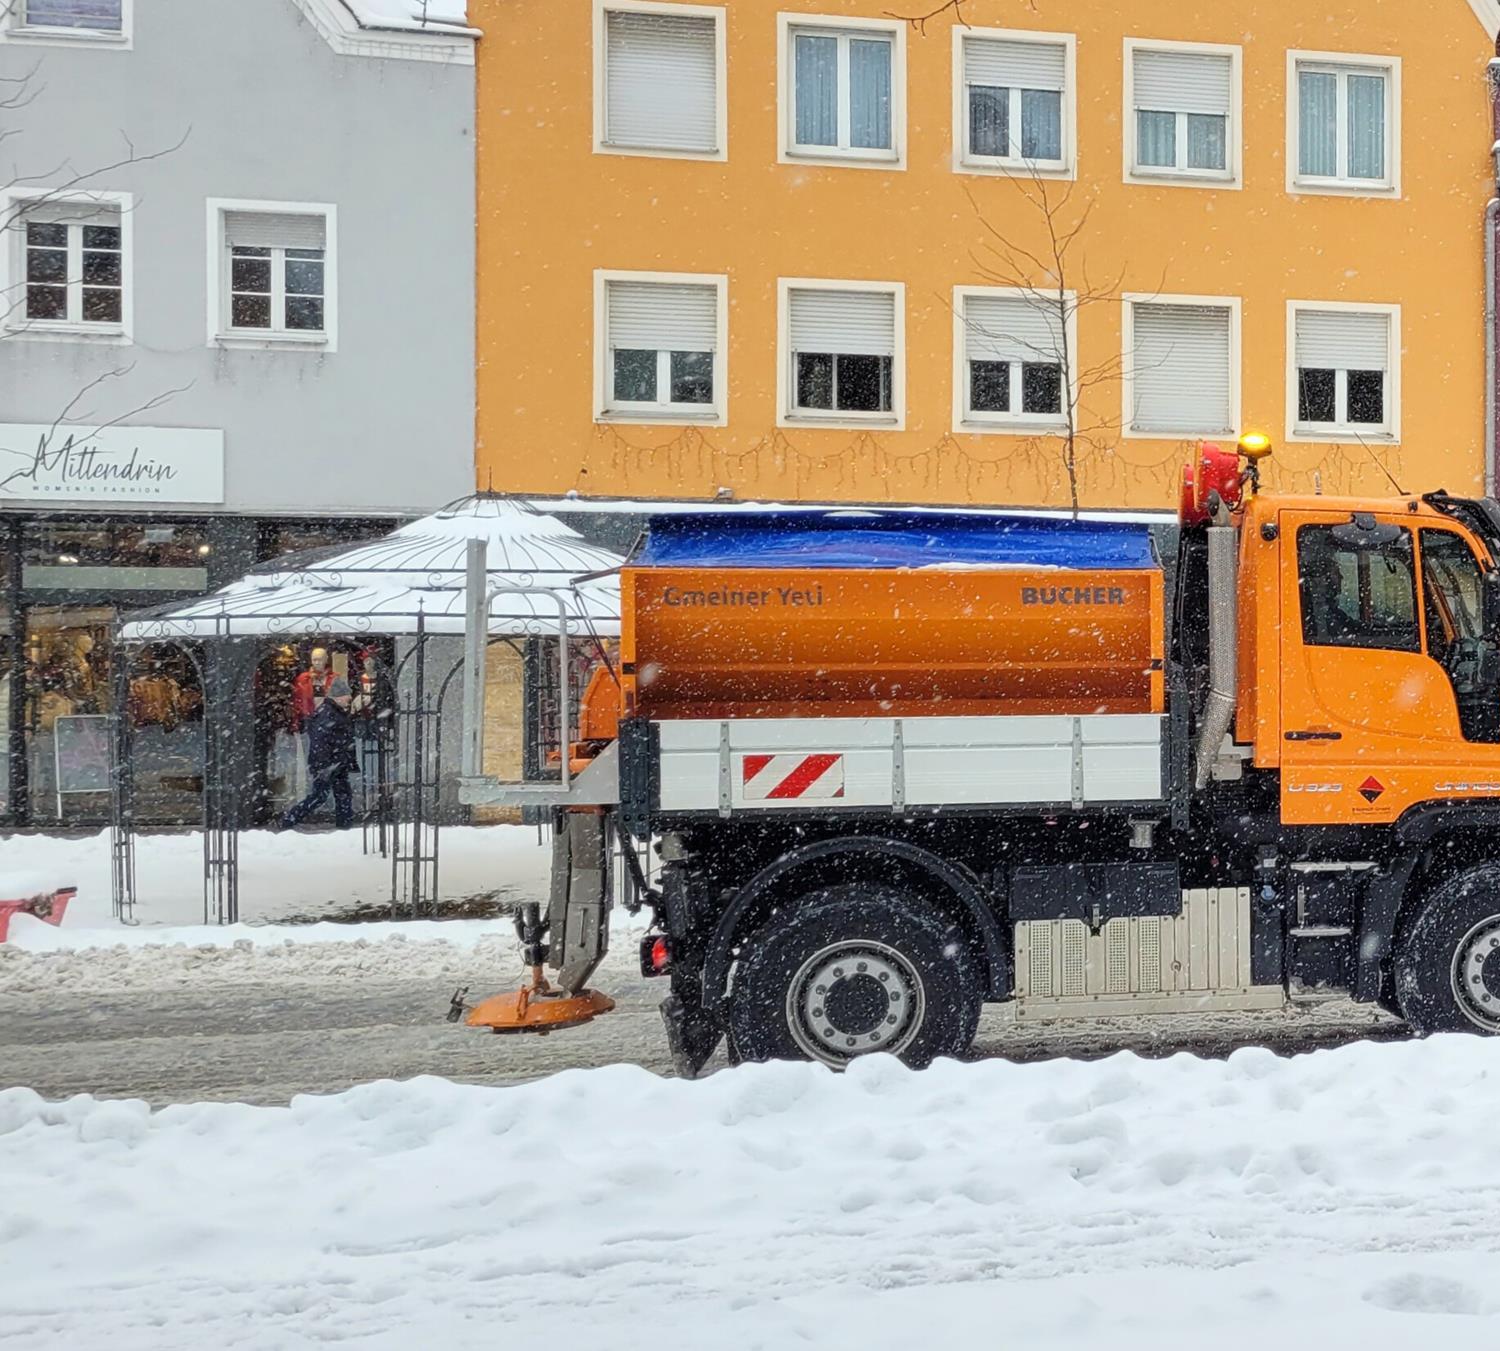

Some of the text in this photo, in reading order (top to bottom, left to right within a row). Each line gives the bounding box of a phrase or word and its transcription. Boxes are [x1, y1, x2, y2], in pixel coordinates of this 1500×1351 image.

[33, 433, 177, 482] Mittendrin
[33, 485, 160, 494] WOMEN'S FASHION
[664, 585, 823, 607] Gmeiner Yeti
[1022, 586, 1124, 605] BUCHER
